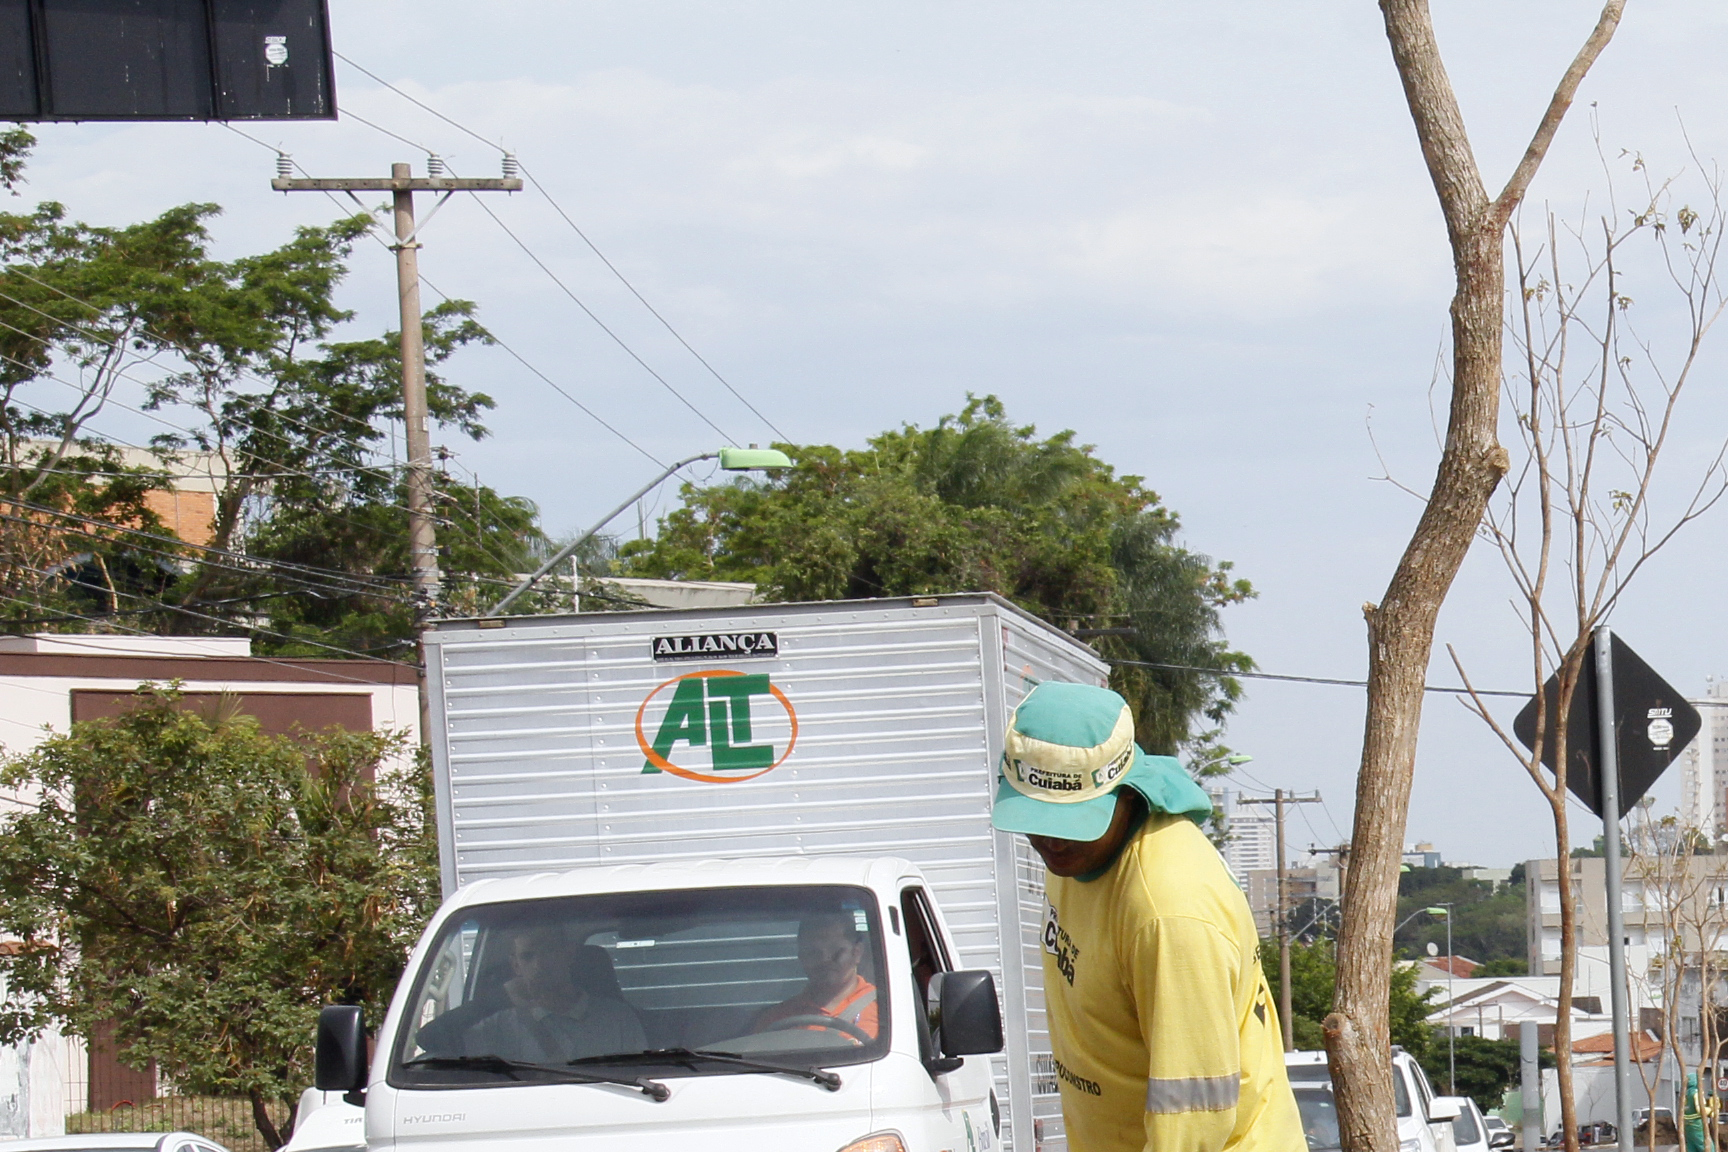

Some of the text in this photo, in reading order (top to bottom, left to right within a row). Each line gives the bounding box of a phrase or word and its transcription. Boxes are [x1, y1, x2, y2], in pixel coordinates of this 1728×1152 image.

[655, 633, 775, 654] ALIANÇA
[1030, 767, 1072, 779] PREFEITURA
[1028, 774, 1083, 792] Cuiabá
[403, 1113, 467, 1125] HYUNDAI
